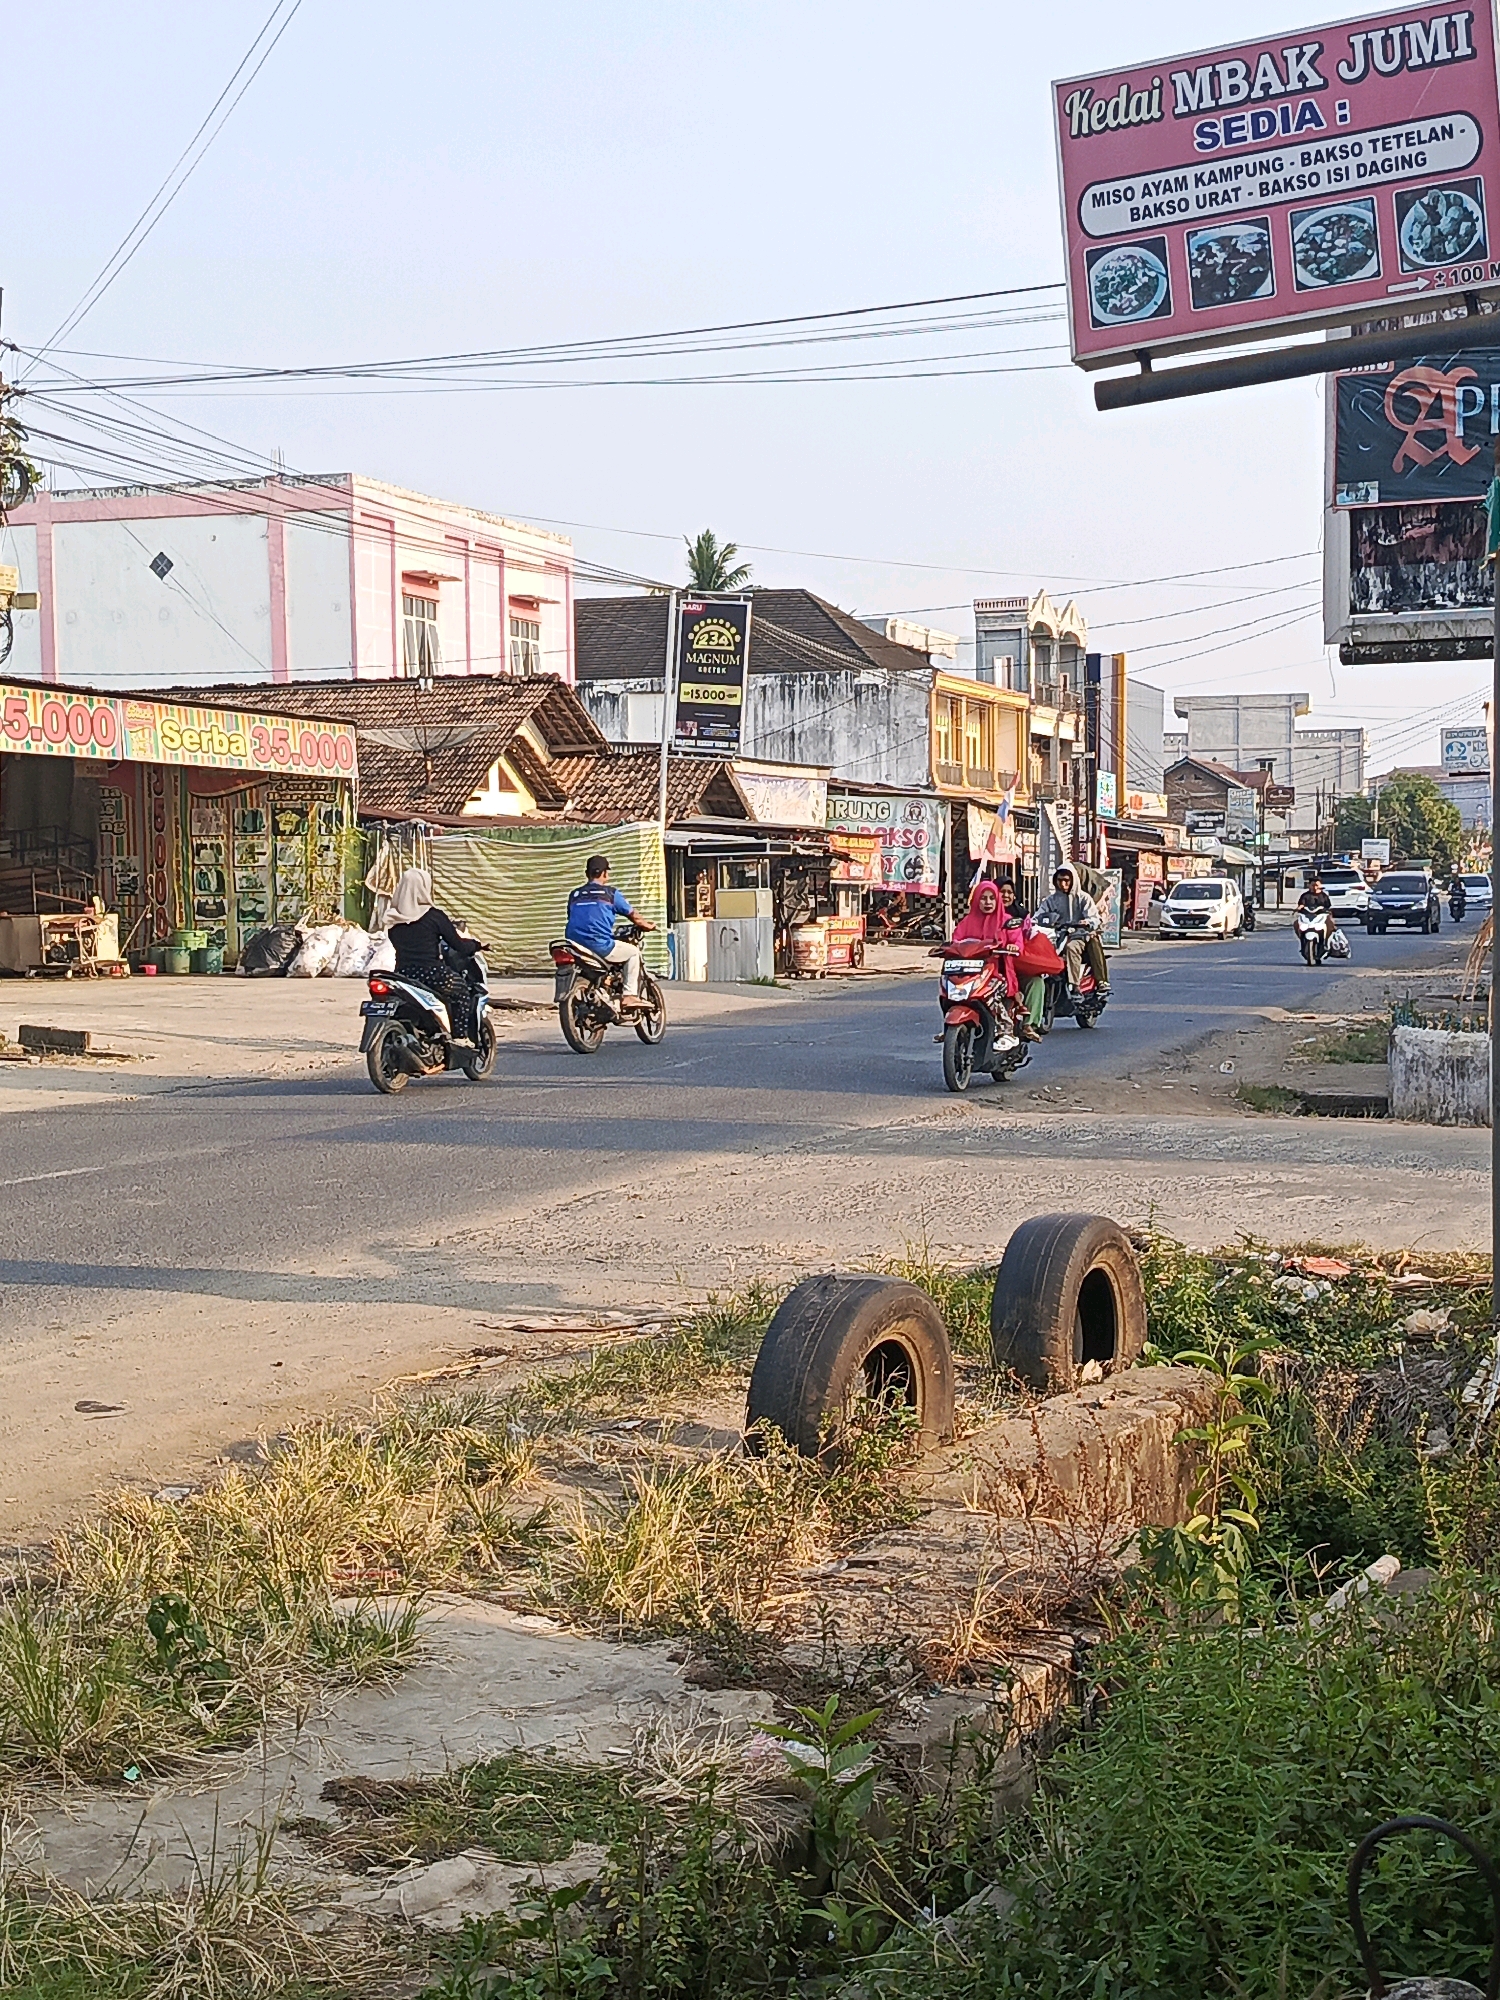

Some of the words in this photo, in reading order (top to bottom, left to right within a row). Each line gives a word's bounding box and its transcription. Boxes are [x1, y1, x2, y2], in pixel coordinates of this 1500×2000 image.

[1065, 77, 1163, 137] Kedai
[1171, 42, 1326, 116] MBAK
[1337, 12, 1473, 81] JUMI
[1195, 100, 1325, 150] SEDIA
[1091, 186, 1136, 209] MISO
[1141, 175, 1189, 200] AYAM
[1194, 157, 1284, 189] KAMPUNG
[1300, 142, 1363, 168] BAKSO
[1368, 123, 1454, 154] TETELAN
[1130, 197, 1190, 223] BAKSO
[1195, 186, 1242, 210] URAT
[1259, 171, 1321, 198] BAKSO
[1326, 166, 1350, 185] ISI
[1356, 151, 1428, 179] DAGING
[686, 652, 740, 666] MAGNUM
[699, 631, 729, 646] 234
[690, 688, 726, 700] 15.000
[0, 696, 117, 748] 5.000
[161, 719, 247, 757] Serba
[251, 725, 354, 771] 35.000
